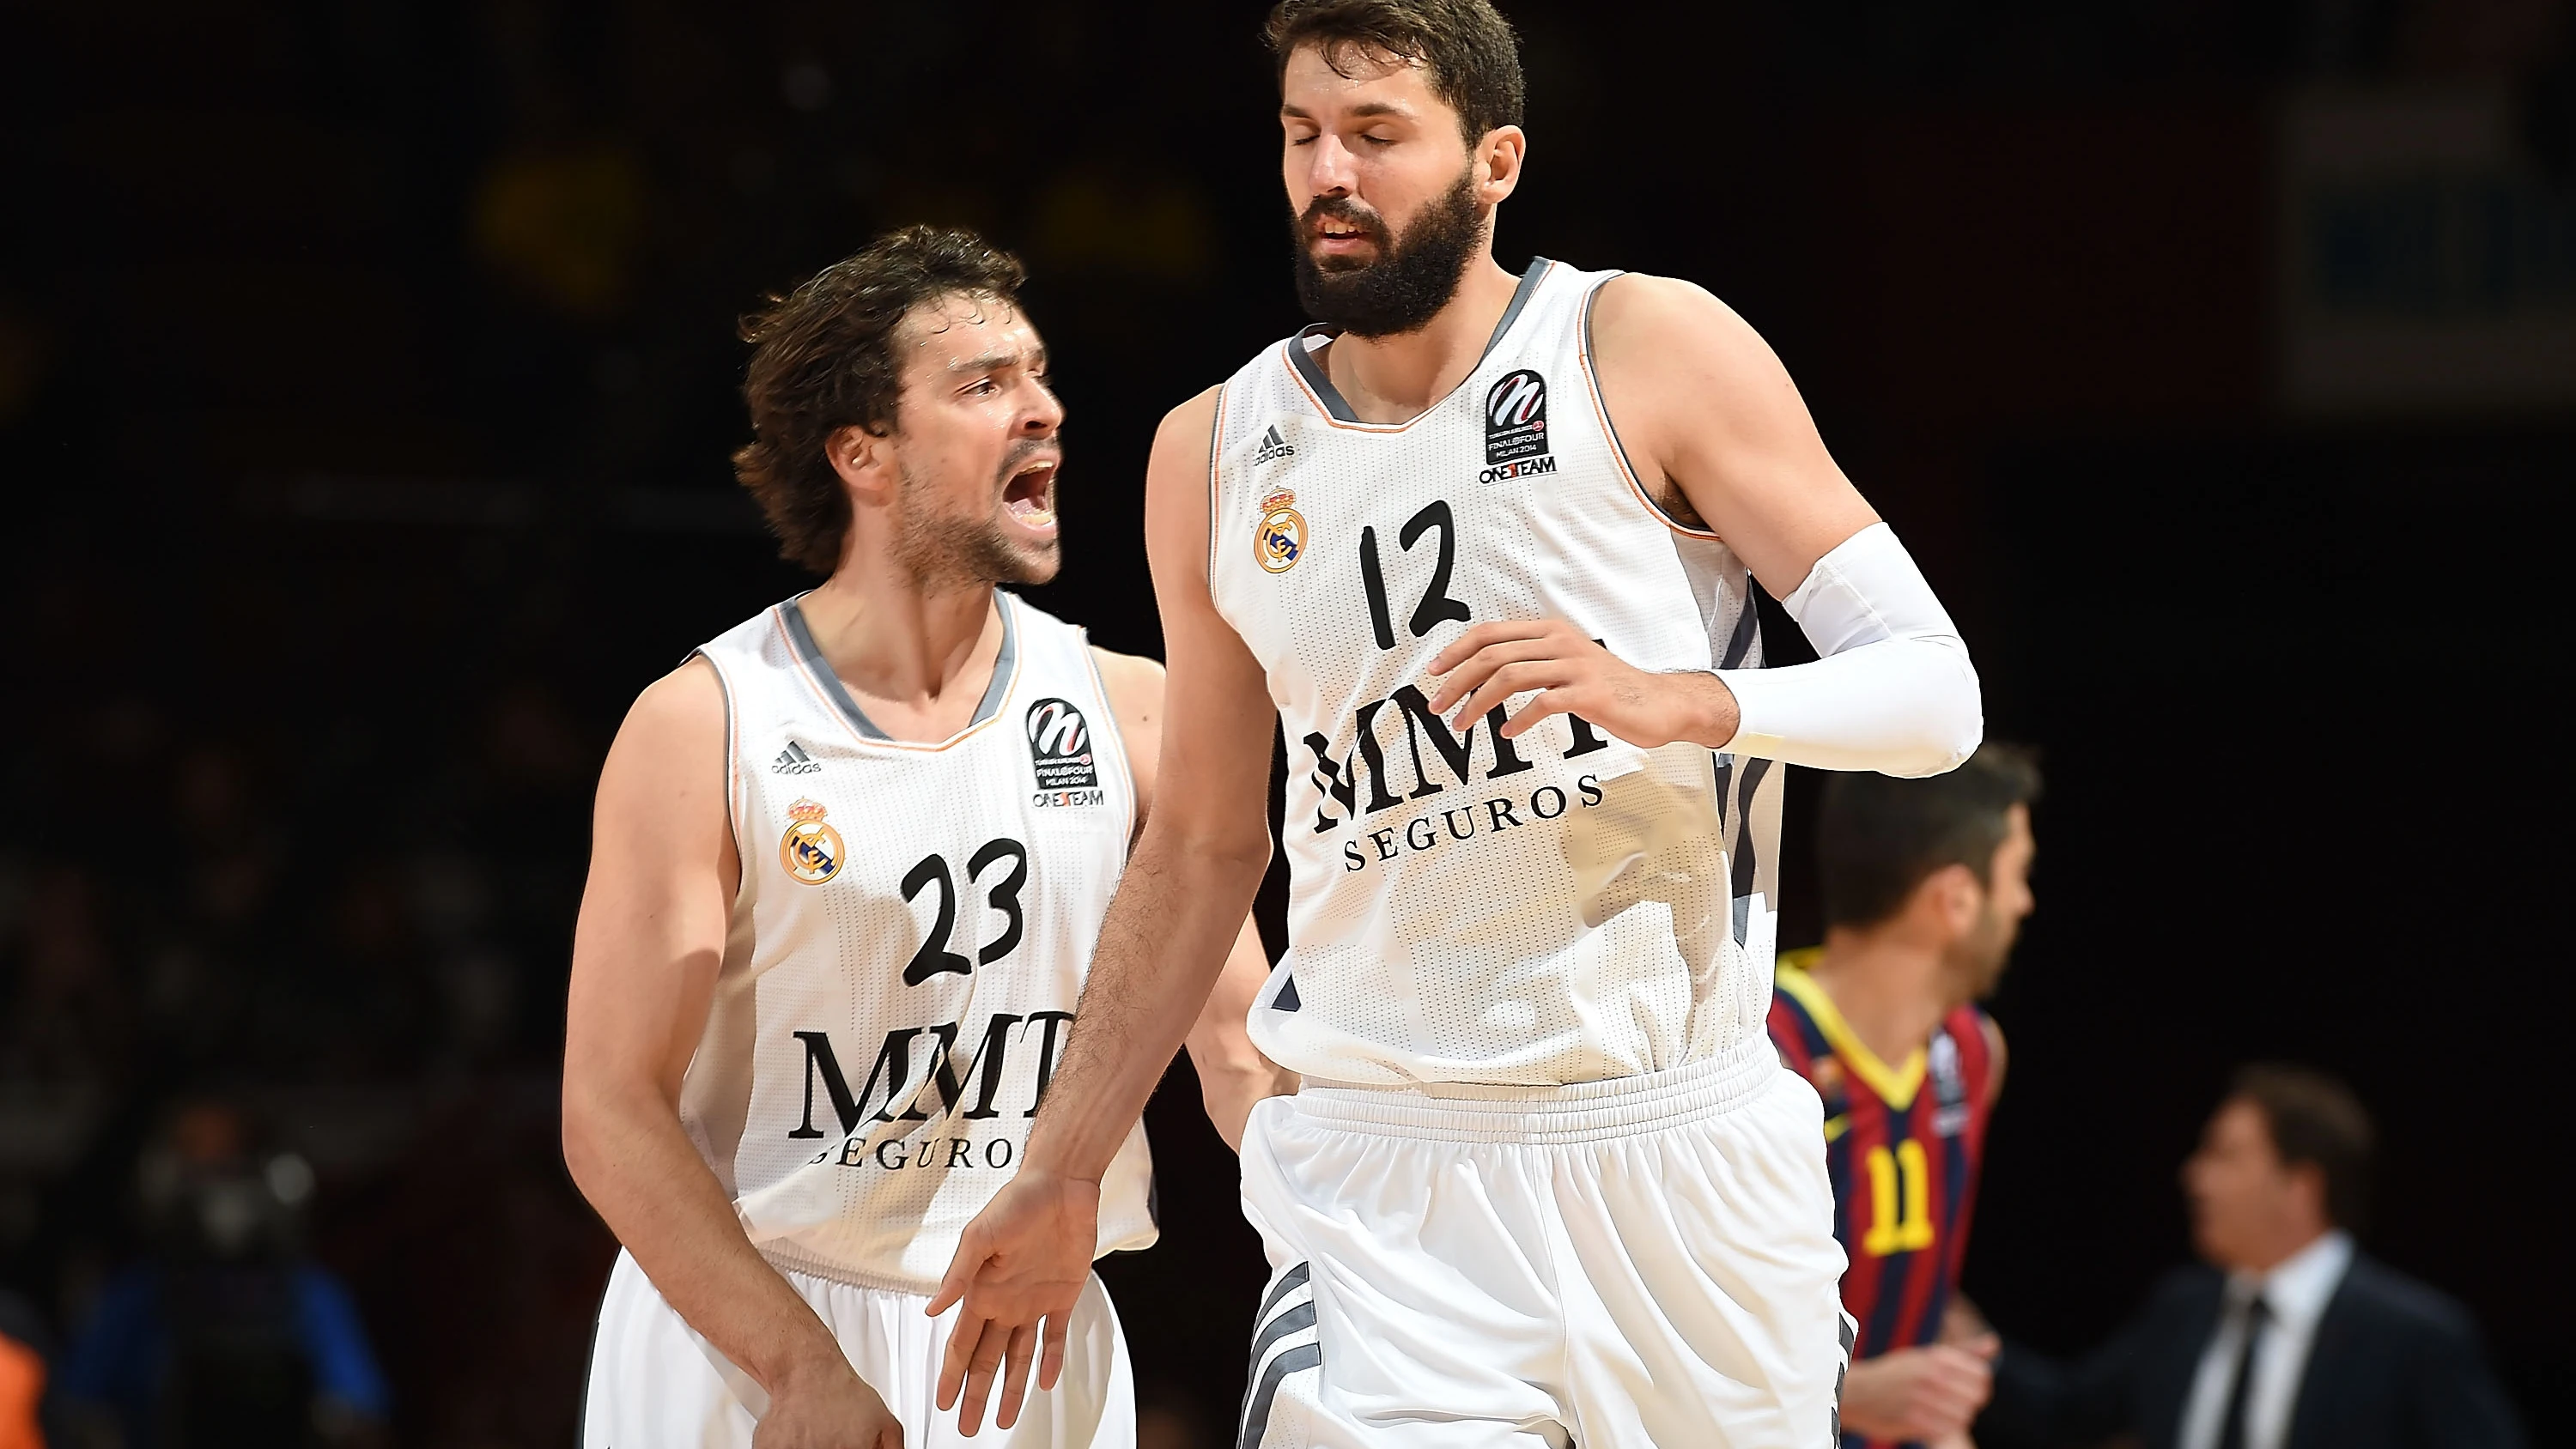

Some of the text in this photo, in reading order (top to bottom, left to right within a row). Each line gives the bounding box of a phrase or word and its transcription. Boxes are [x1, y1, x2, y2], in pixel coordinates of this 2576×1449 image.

[1254, 445, 1295, 466] adidas
[1359, 500, 1471, 651] 12
[771, 762, 822, 774] adidas
[1344, 774, 1603, 872] SEGUROS
[901, 838, 1027, 987] 23
[1862, 1137, 1935, 1258] 11
